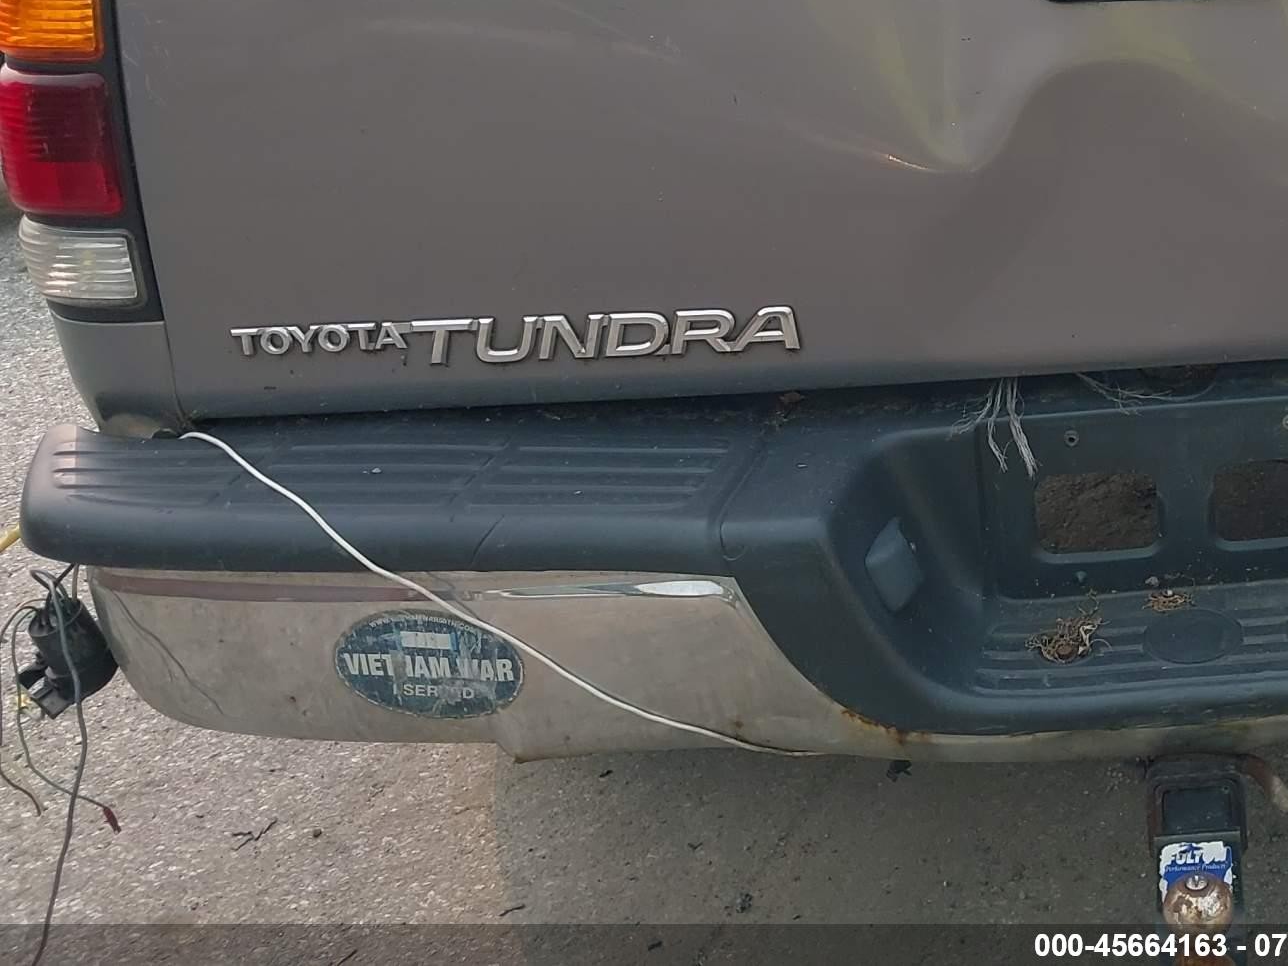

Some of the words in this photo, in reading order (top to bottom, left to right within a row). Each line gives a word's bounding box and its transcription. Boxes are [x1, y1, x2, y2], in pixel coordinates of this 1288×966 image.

[230, 320, 408, 356] TOYOTA
[408, 305, 801, 365] TUNDRA
[403, 683, 475, 699] SERD
